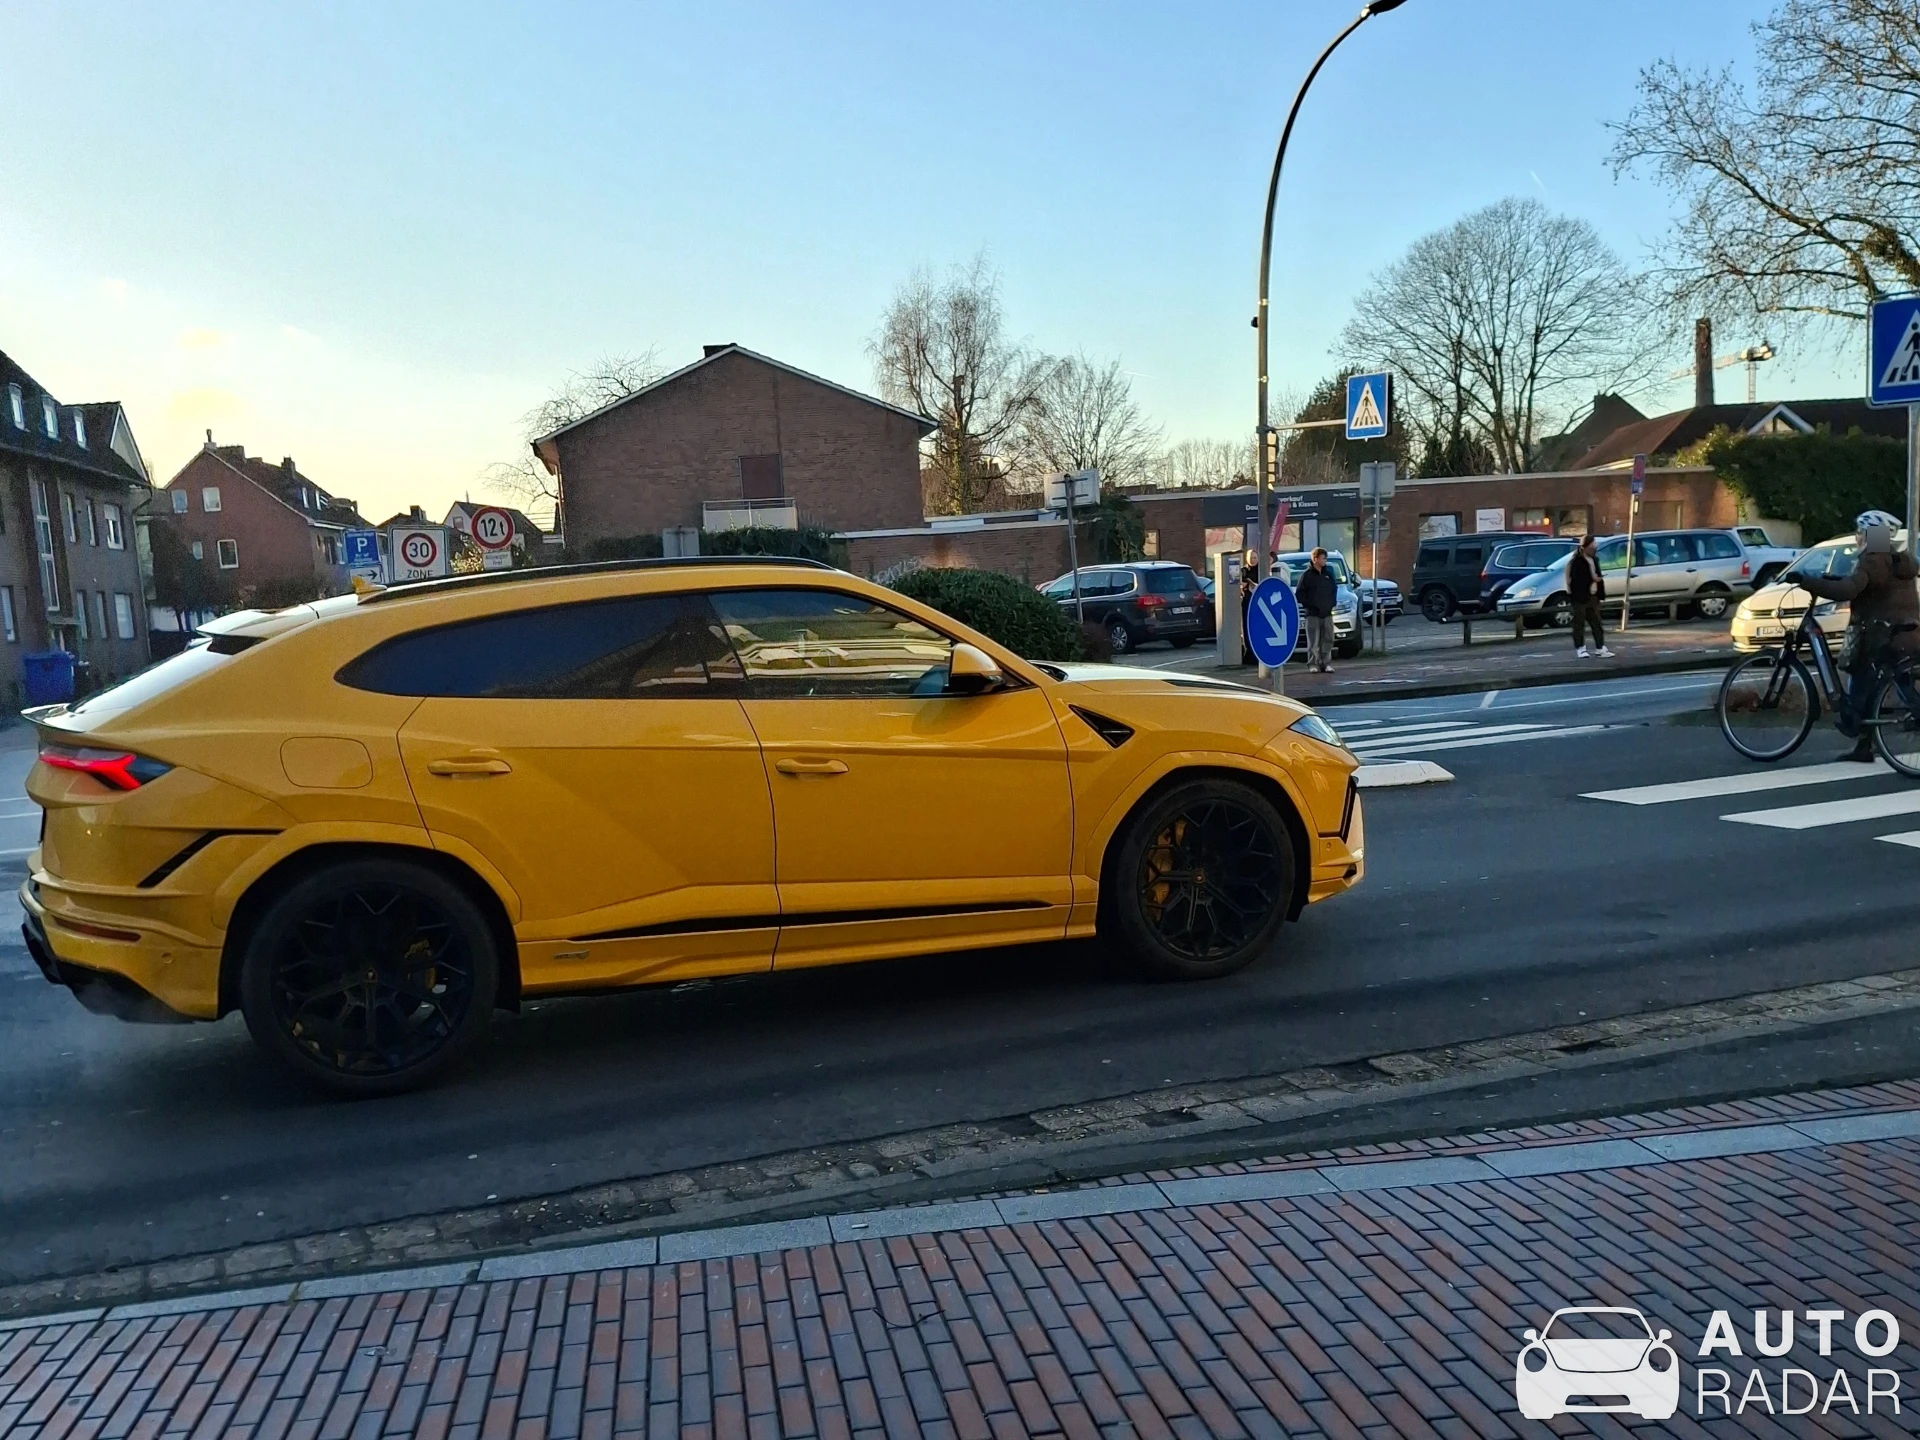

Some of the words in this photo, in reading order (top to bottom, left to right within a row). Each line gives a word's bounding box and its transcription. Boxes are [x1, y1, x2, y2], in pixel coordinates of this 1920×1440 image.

[1278, 495, 1303, 503] verkauf
[356, 537, 368, 553] P
[409, 542, 430, 558] 30
[406, 569, 434, 579] ZONE
